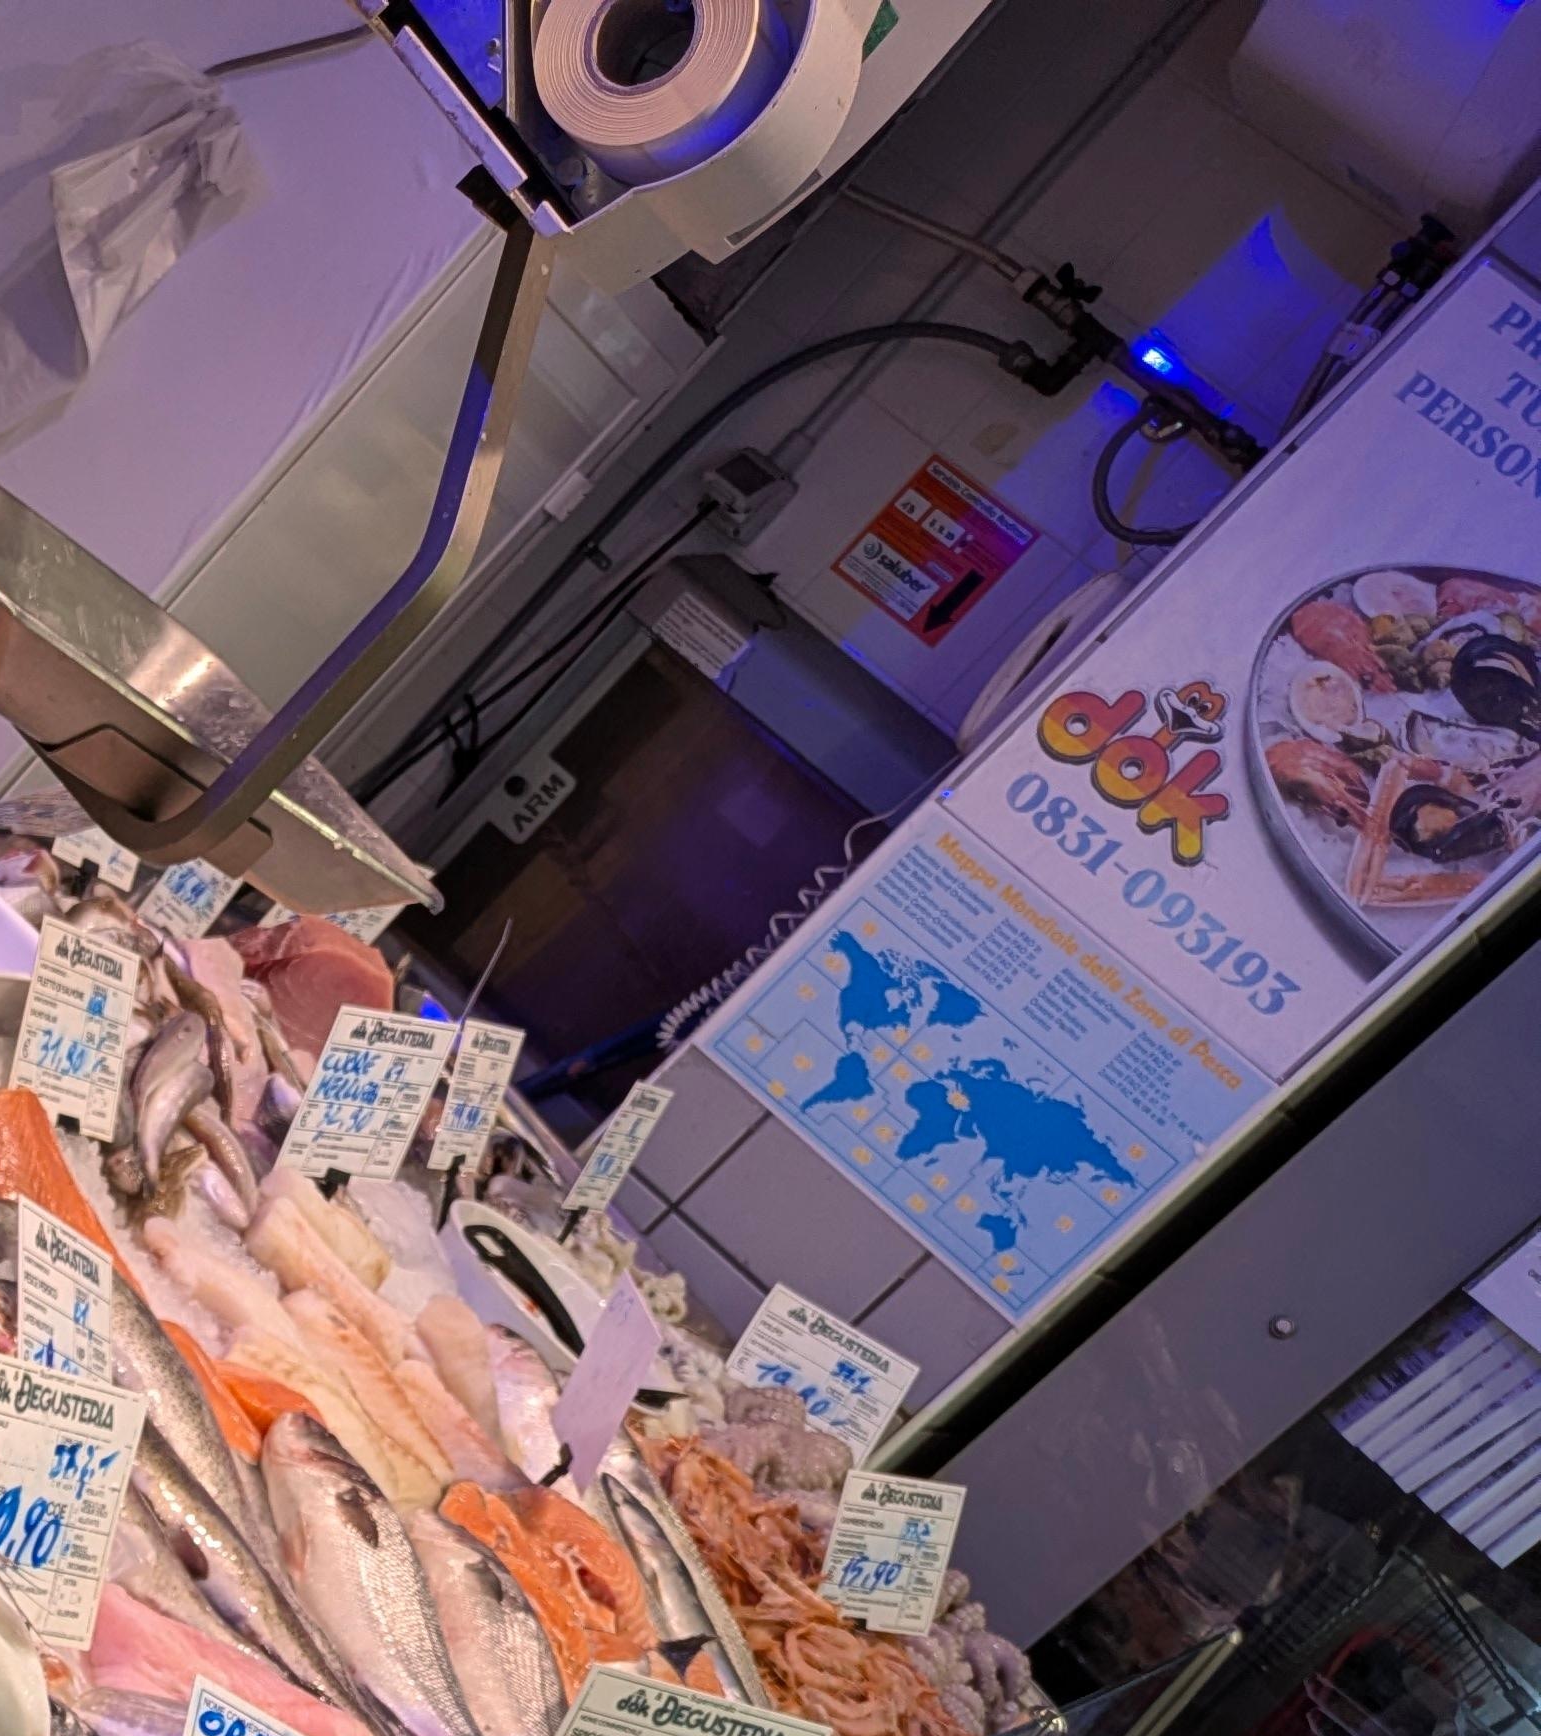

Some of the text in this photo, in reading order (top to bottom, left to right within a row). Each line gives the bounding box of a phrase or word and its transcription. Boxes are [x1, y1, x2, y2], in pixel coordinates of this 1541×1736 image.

[1006, 772, 1301, 1015] 0831-093193
[1036, 690, 1230, 867] dok
[937, 832, 999, 891] Mappa
[999, 884, 1078, 955] Mondiale
[1079, 953, 1123, 992] delle
[1123, 987, 1169, 1029] Zone
[1168, 1026, 1193, 1046] di
[1190, 1040, 1243, 1091] Pesca
